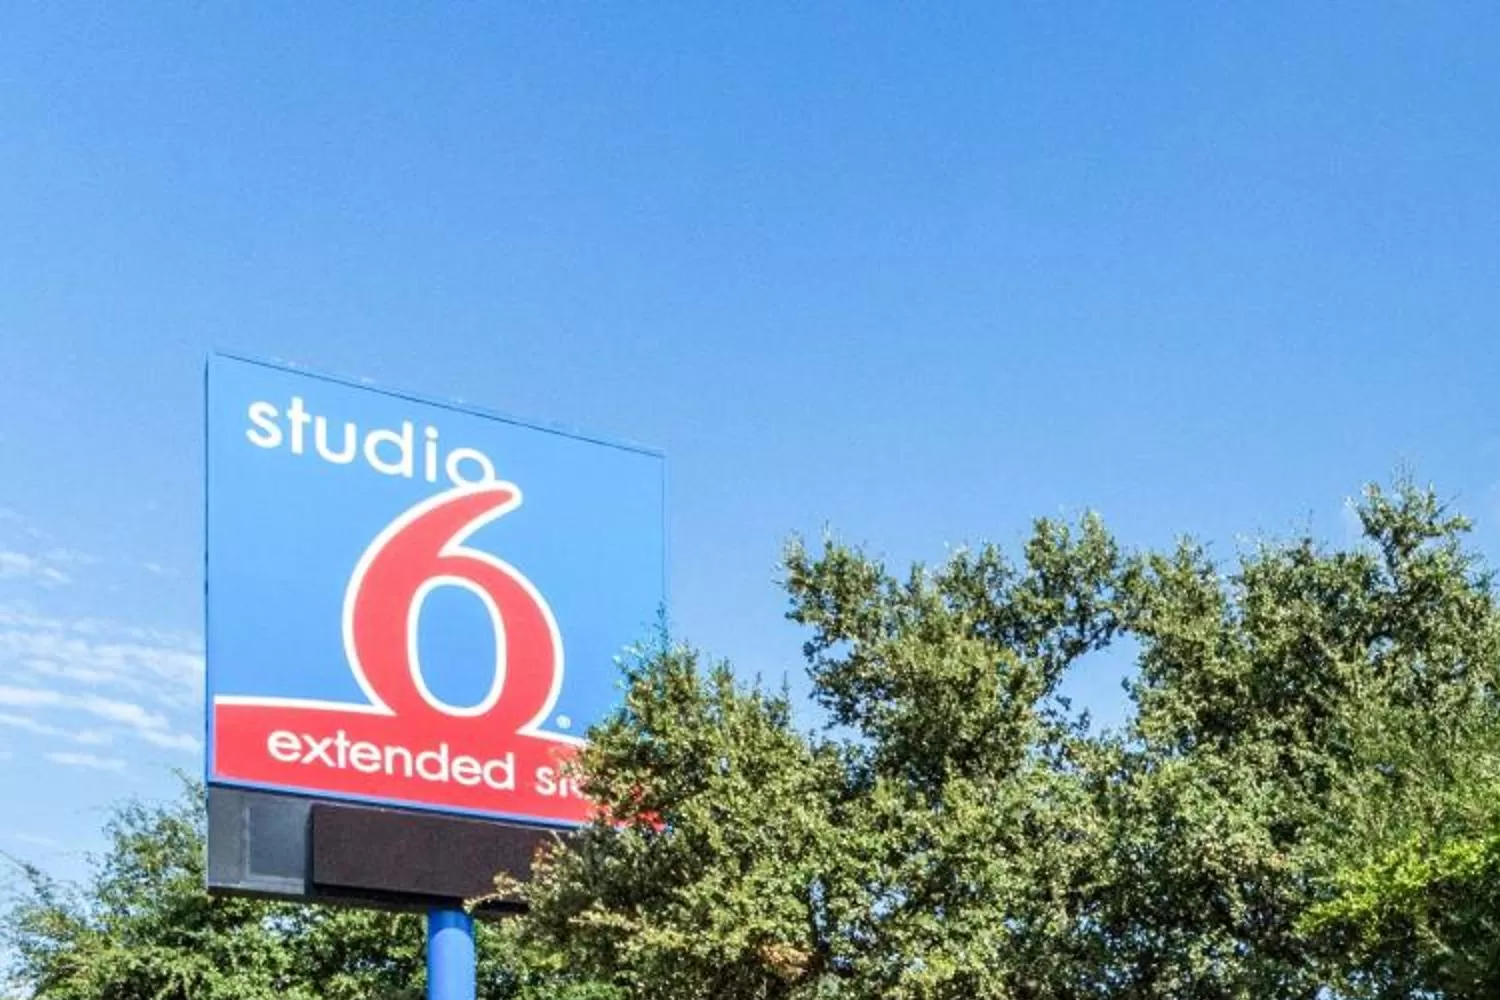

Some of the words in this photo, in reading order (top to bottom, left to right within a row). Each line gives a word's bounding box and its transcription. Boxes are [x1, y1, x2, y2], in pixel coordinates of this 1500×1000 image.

[245, 396, 497, 488] studio
[343, 480, 566, 736] 6
[266, 729, 516, 791] extended
